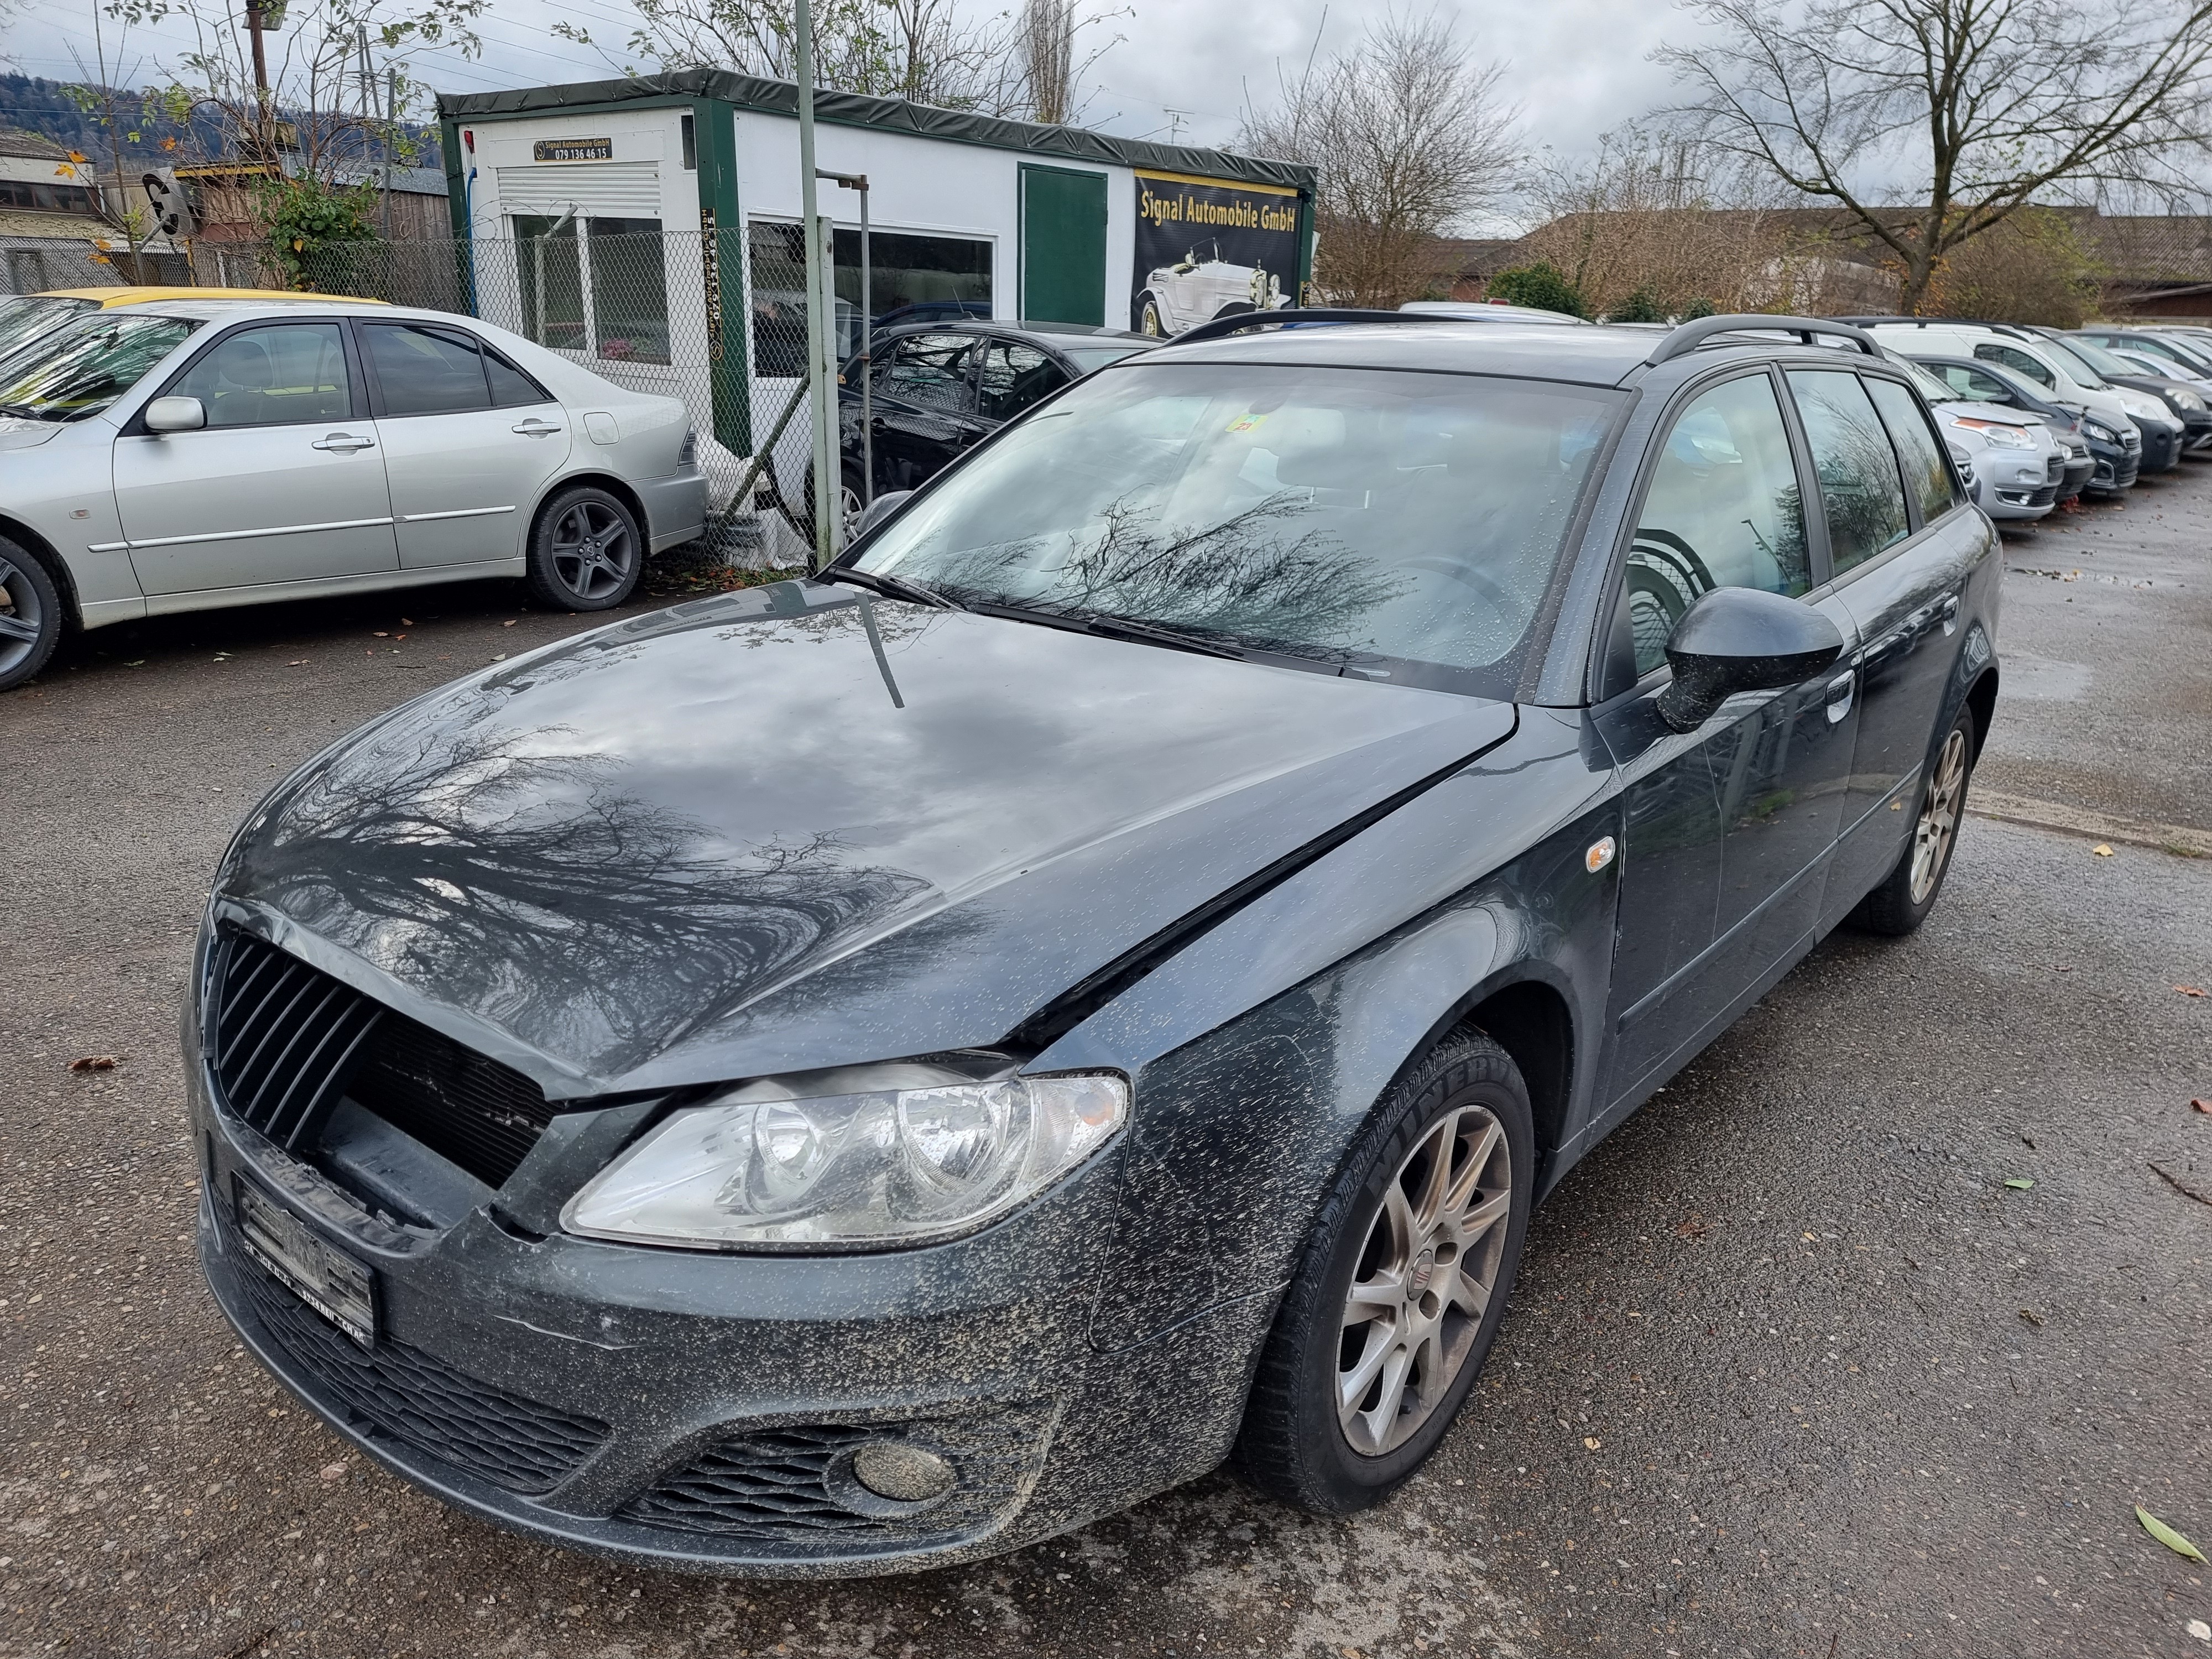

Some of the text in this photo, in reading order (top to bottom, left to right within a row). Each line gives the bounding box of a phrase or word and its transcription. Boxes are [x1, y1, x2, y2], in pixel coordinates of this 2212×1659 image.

[545, 139, 609, 150] Signal Automobile GmbH
[555, 148, 607, 160] 079 136 46 15
[1141, 190, 1296, 232] Signal Automobile GmbH
[707, 217, 715, 233] 15
[708, 239, 716, 257] 46
